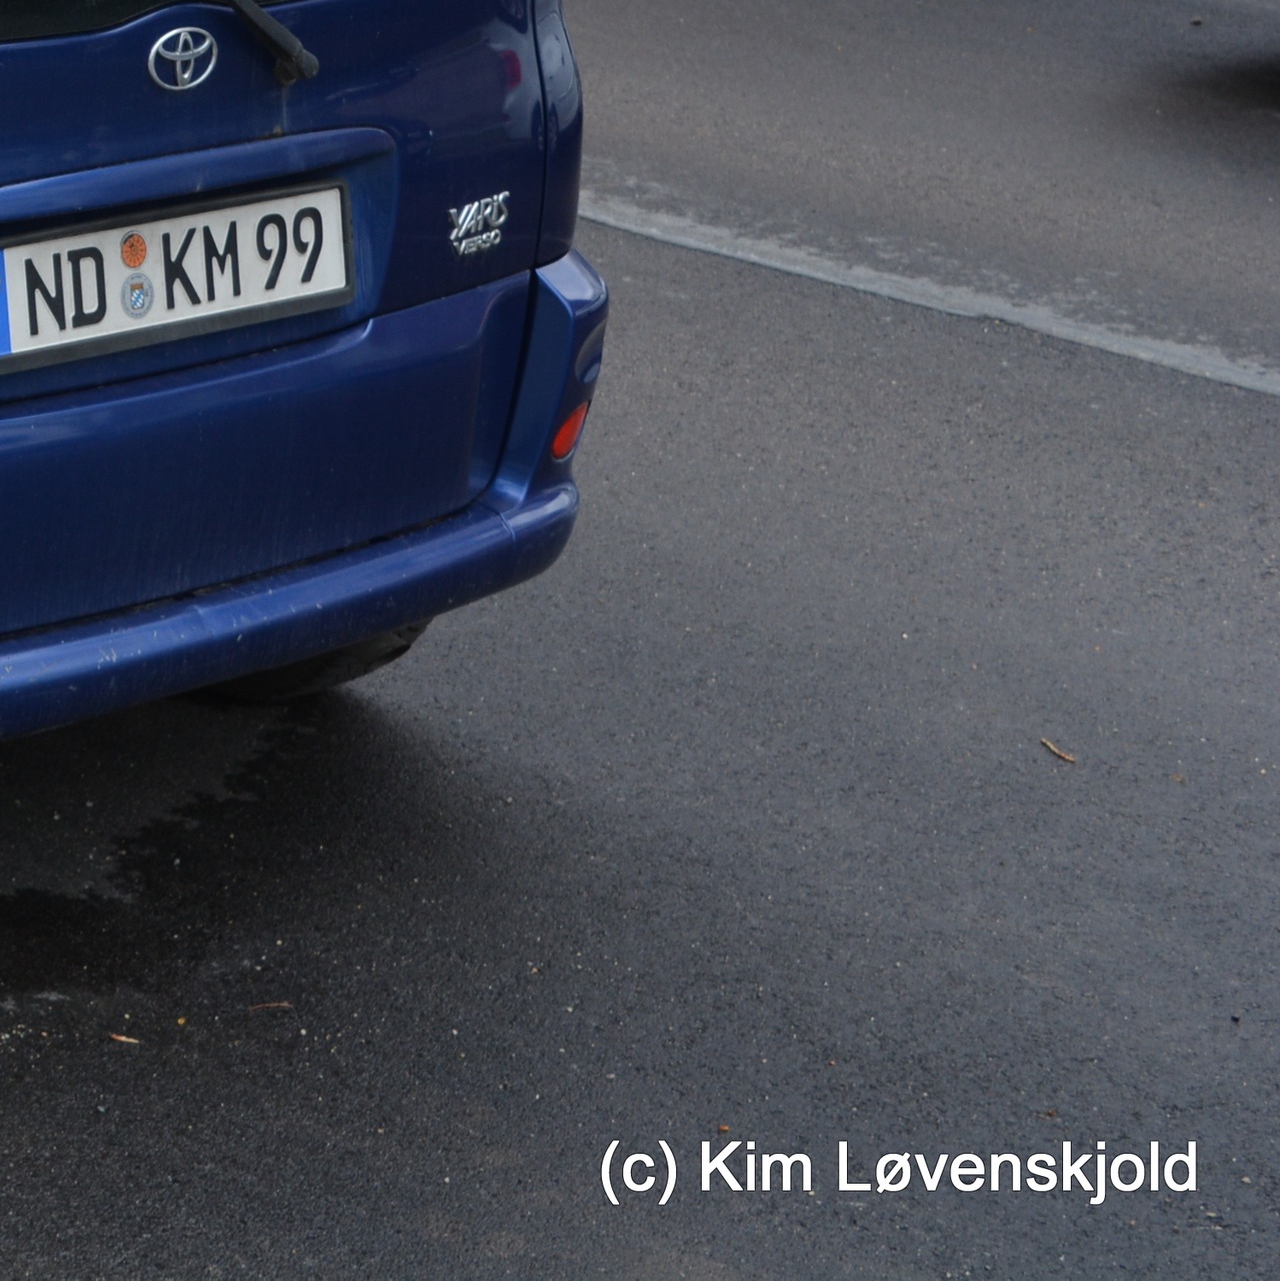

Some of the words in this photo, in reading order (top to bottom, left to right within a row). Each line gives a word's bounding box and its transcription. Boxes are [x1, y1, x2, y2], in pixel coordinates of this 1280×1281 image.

[24, 245, 107, 336] ND
[161, 221, 242, 310] KM
[255, 206, 324, 291] 99
[453, 229, 501, 255] VERSO
